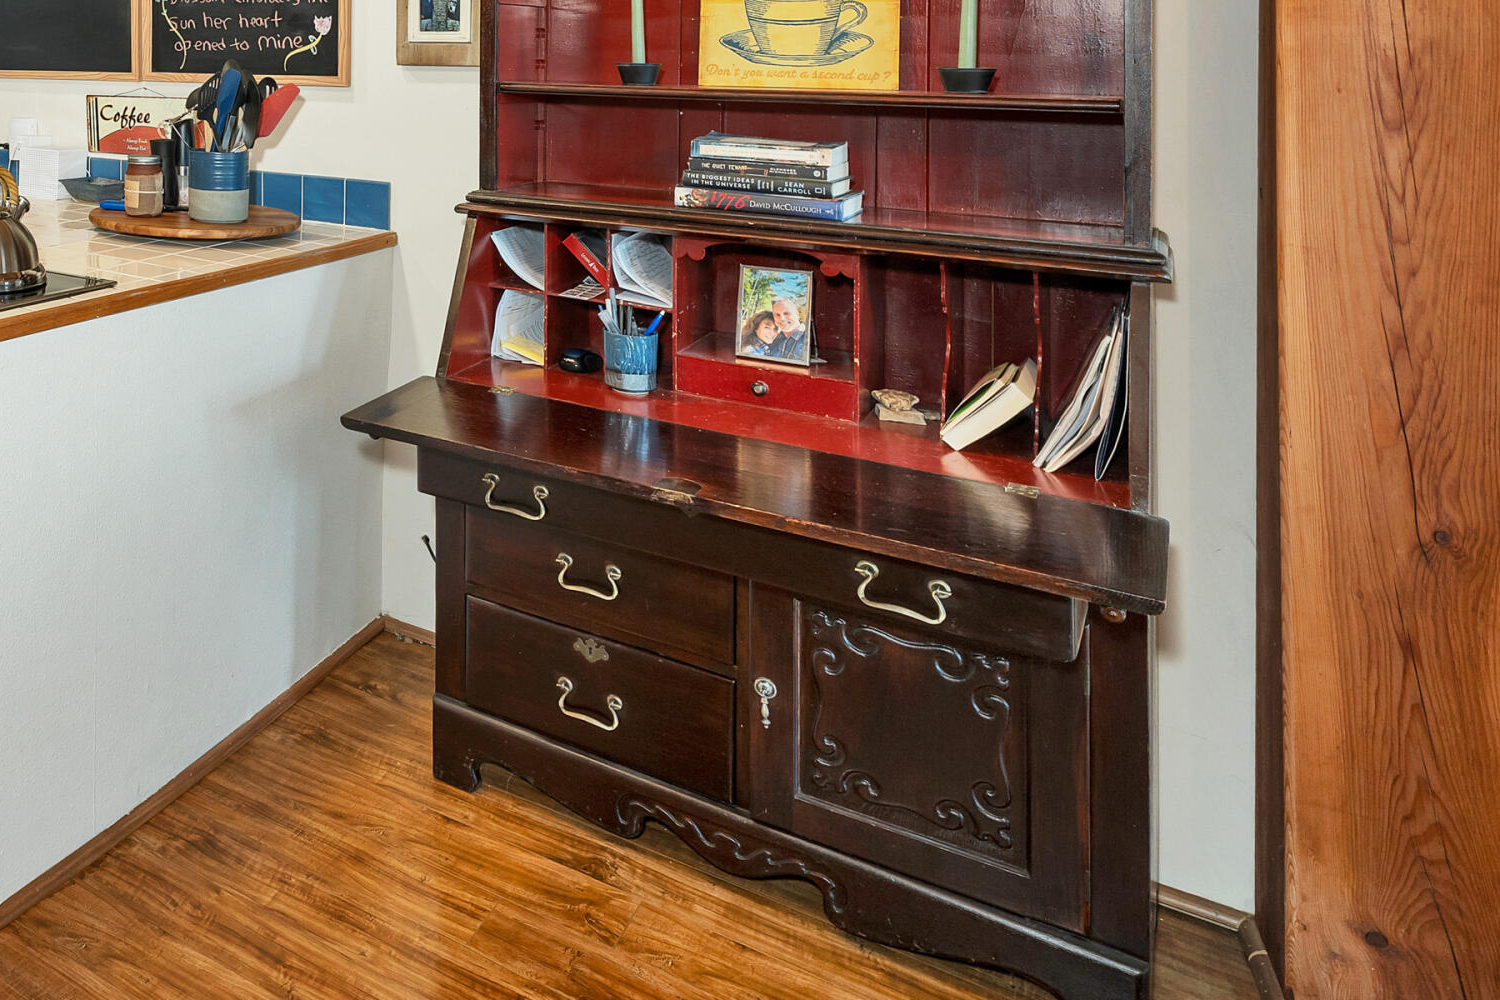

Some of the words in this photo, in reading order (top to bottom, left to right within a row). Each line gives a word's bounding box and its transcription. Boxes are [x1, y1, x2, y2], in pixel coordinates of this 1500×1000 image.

[203, 11, 232, 30] her
[239, 11, 283, 29] heart
[229, 38, 250, 51] to
[258, 34, 303, 51] mine
[706, 64, 740, 77] Don't
[741, 68, 762, 79] you
[767, 70, 796, 79] want
[800, 71, 809, 79] a
[812, 68, 856, 80] second
[857, 71, 880, 84] cup
[100, 104, 151, 130] Coffee
[715, 181, 751, 190] UNIVERSE
[733, 176, 755, 184] IDEAS
[777, 187, 812, 195] CARROLL
[710, 190, 751, 211] 1776
[749, 200, 771, 209] DAVID
